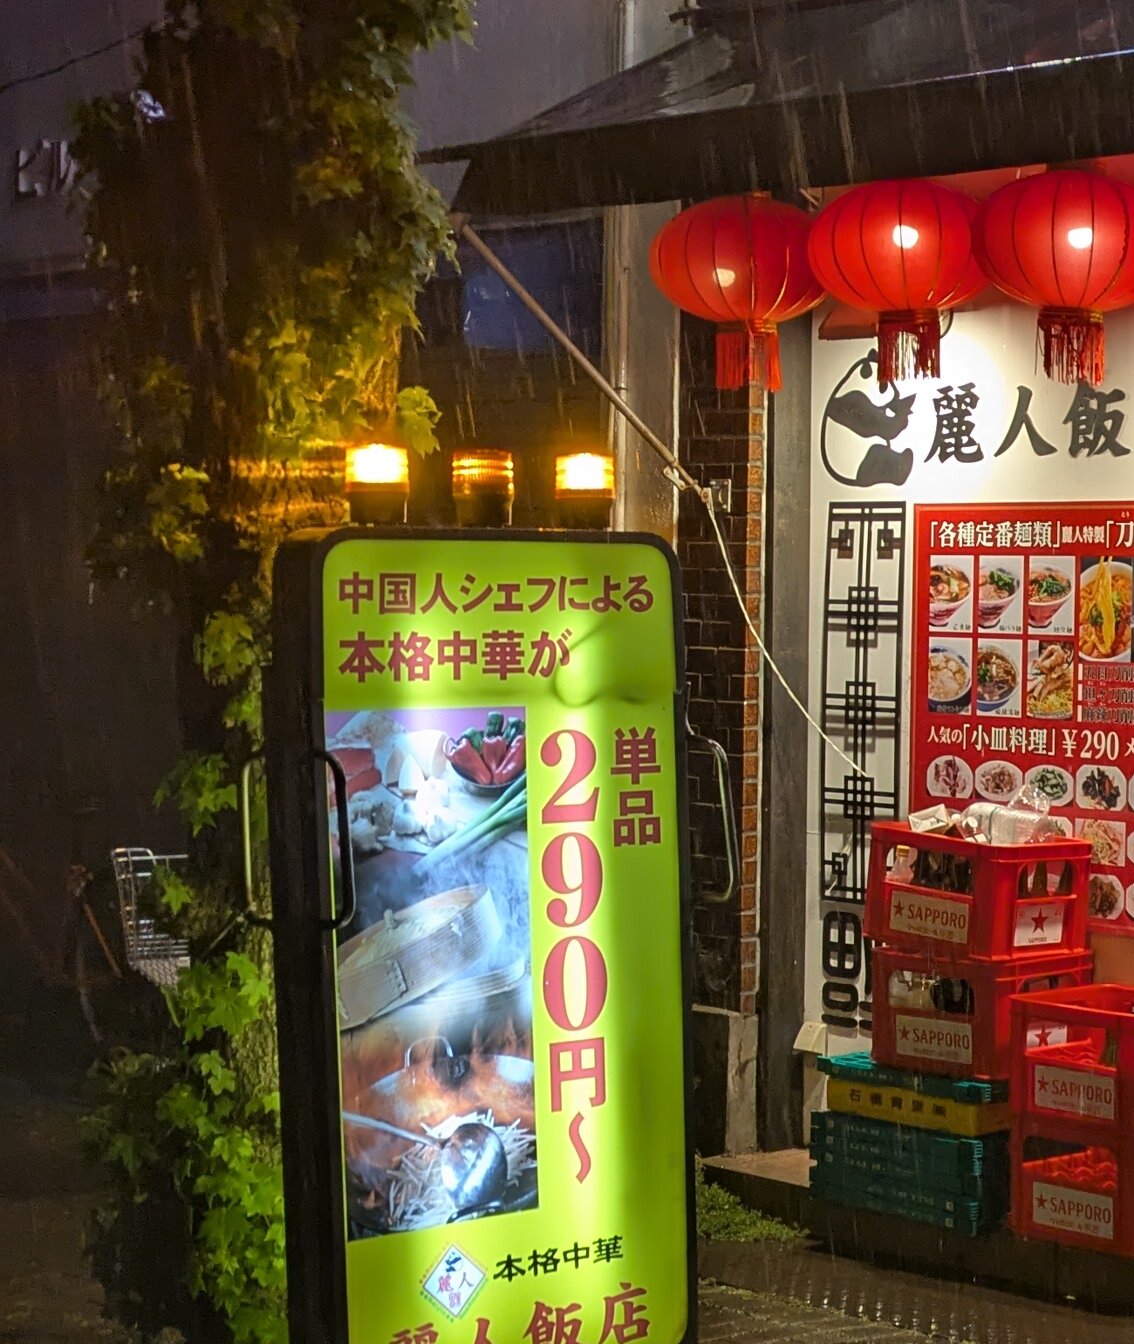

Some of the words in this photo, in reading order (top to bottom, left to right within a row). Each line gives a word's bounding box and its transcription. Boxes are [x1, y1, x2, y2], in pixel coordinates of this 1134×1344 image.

[338, 570, 655, 617] 中国人シェフによる
[338, 629, 571, 684] 本格中華が
[1061, 729, 1120, 760] ¥290
[609, 726, 662, 847] 単品
[908, 903, 967, 929] SAPPORO
[912, 1028, 970, 1050] SAPPORO
[1051, 1079, 1112, 1105] SAPPORO
[1049, 1196, 1112, 1225] SAPPORO
[493, 1235, 625, 1284] 本格中華
